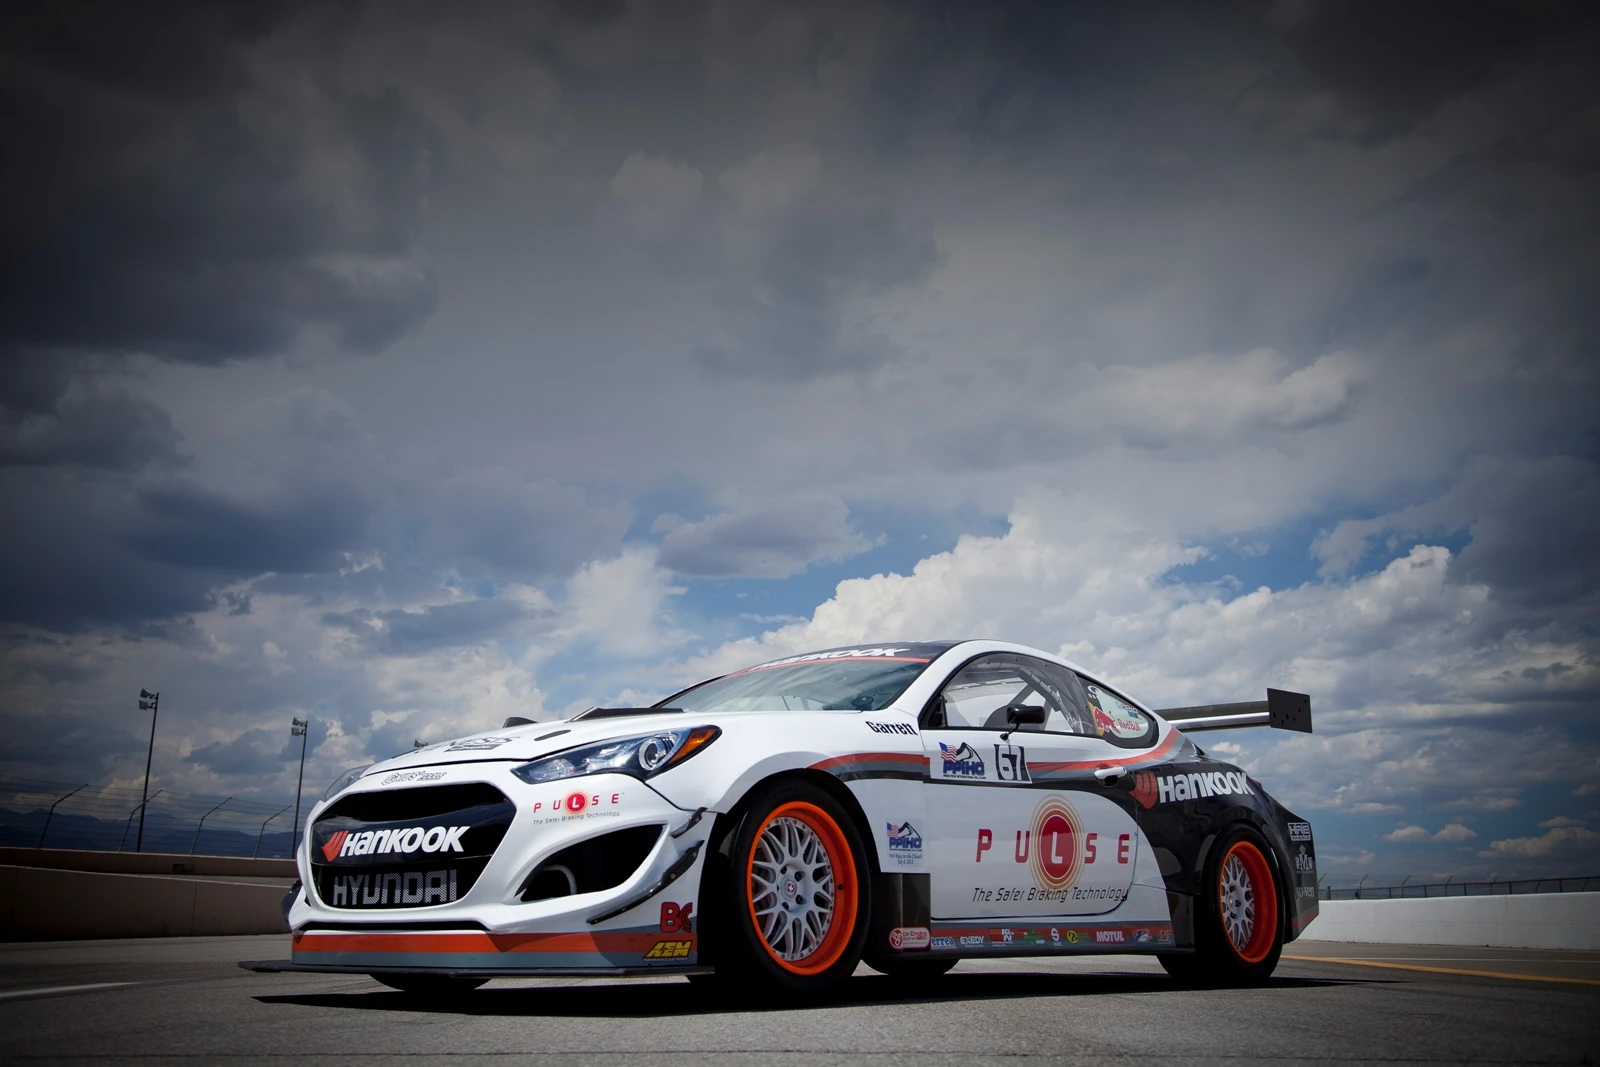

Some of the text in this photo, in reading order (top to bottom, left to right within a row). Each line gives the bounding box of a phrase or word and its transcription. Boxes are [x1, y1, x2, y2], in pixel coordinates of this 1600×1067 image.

[865, 721, 918, 735] Garrett
[998, 744, 1023, 780] 67
[533, 793, 619, 813] PULSE
[586, 811, 621, 819] Technology
[975, 828, 1130, 864] PULSE
[333, 869, 457, 905] HYUNDAI
[972, 886, 1129, 903] The Safer Braking Technology
[660, 901, 693, 933] BC
[931, 937, 955, 946] errea
[960, 936, 985, 944] EXEDY
[1096, 930, 1125, 942] MOTUL
[643, 940, 692, 958] AEM
